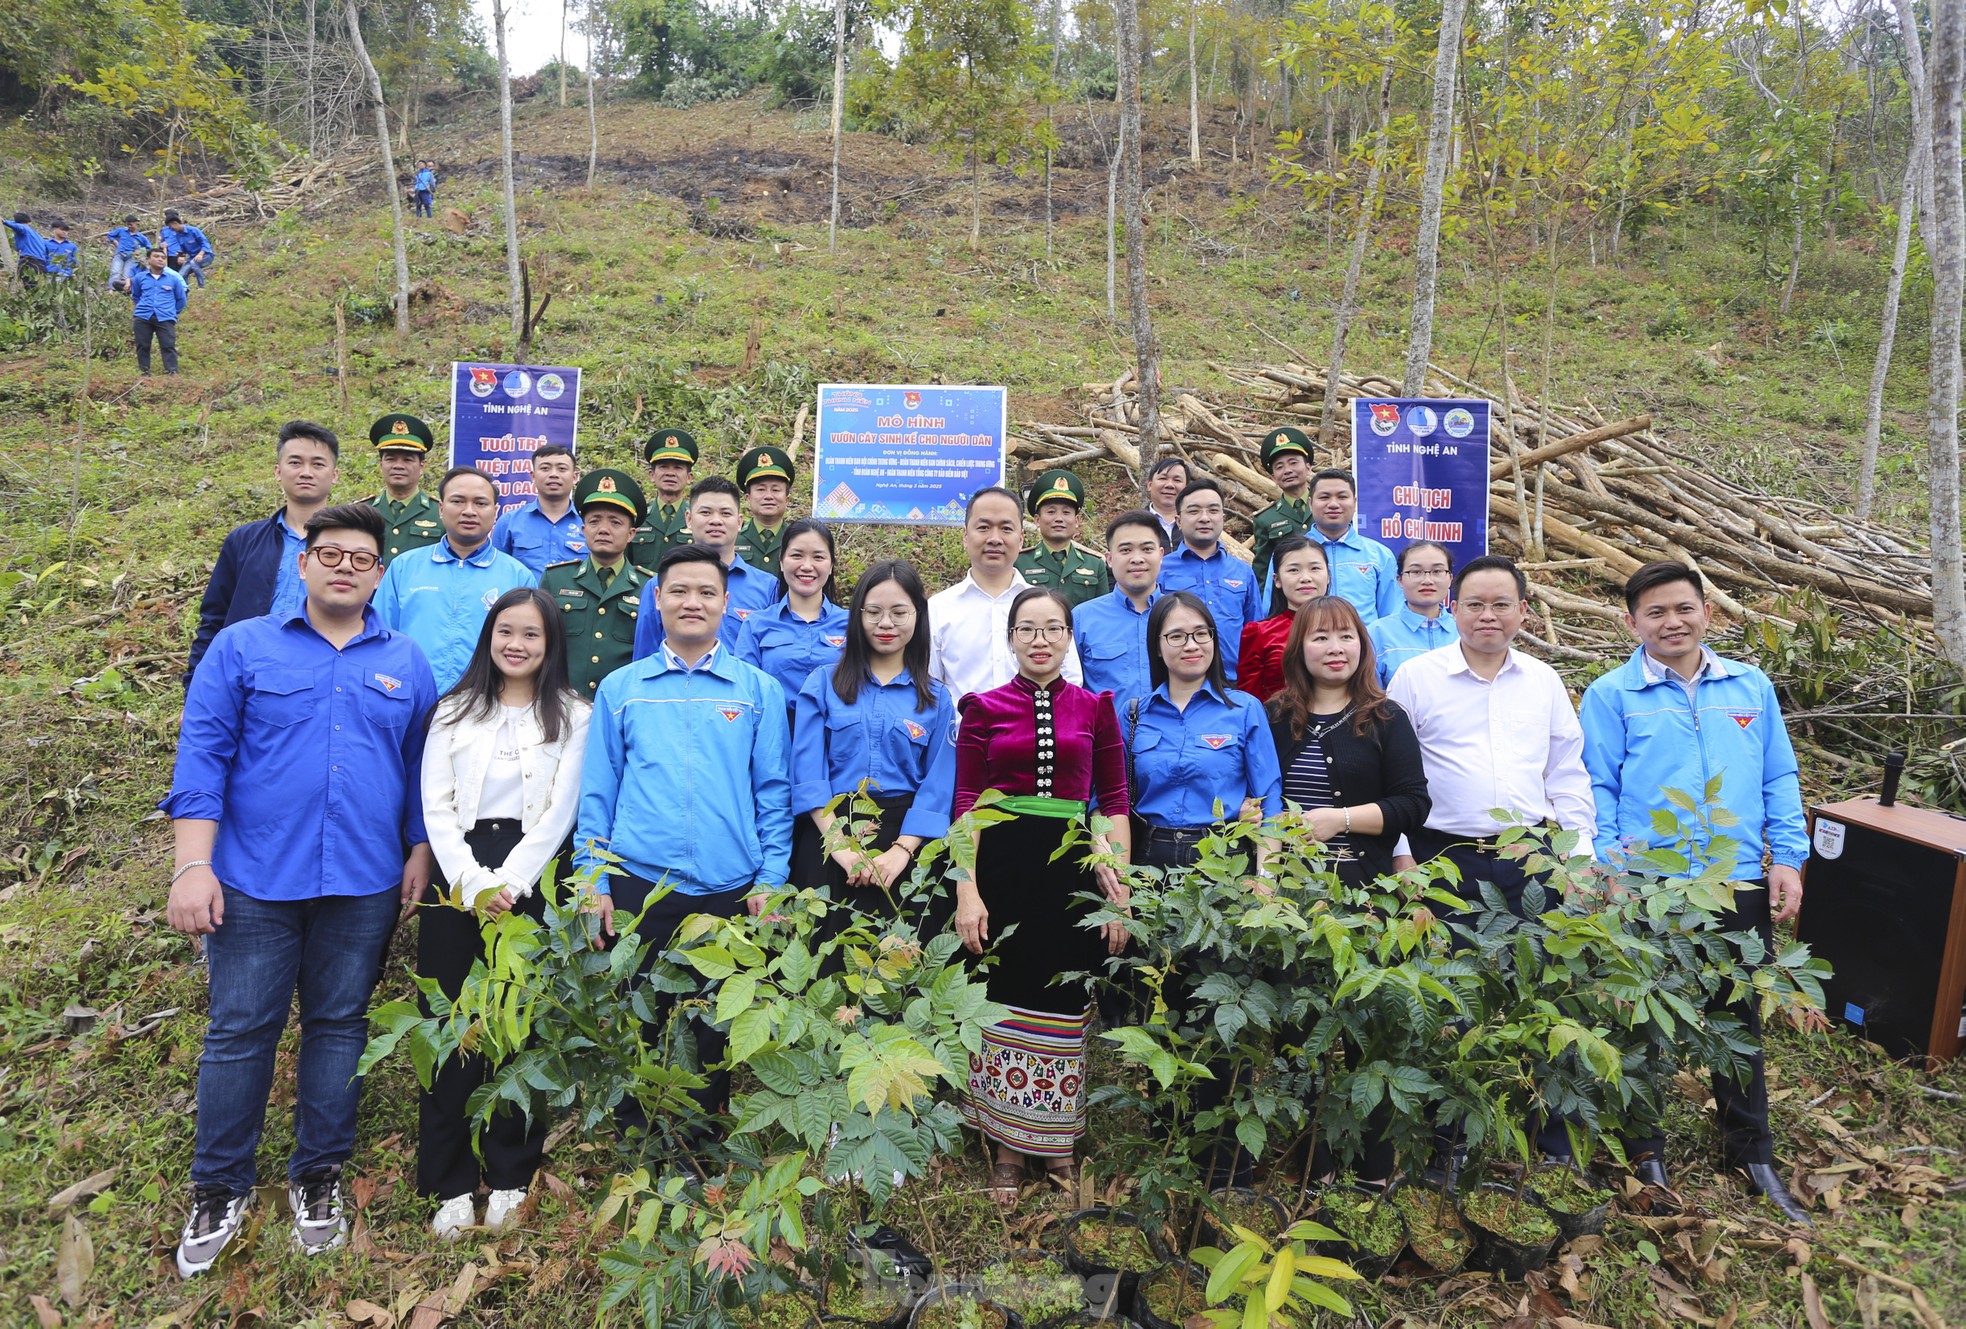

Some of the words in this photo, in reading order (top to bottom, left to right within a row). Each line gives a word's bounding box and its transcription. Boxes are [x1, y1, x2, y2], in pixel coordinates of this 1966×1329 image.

[483, 402, 504, 414] TỈNH
[507, 404, 531, 416] NGHỆ
[534, 407, 548, 415] AN
[877, 414, 903, 428] MÔ
[907, 414, 945, 429] HÌNH
[480, 433, 515, 452] TUỔI
[830, 430, 856, 444] VƯỜN
[858, 431, 877, 444] CÂY
[879, 432, 902, 444] SINH
[904, 431, 918, 444] KẾ
[919, 434, 938, 445] CHO
[940, 432, 970, 446] NGƯỜI
[972, 434, 992, 447] DÂN
[1386, 441, 1410, 454] TỈNH
[1413, 444, 1440, 457] NGHỆ
[1442, 446, 1458, 456] AN
[476, 458, 510, 477] VIỆT
[512, 459, 533, 474] NA
[1393, 480, 1419, 506] CHỦ
[1420, 488, 1452, 512] TỊCH
[1382, 512, 1402, 538] HỒ
[1404, 516, 1423, 540] CHÍ
[1425, 522, 1462, 542] MINH
